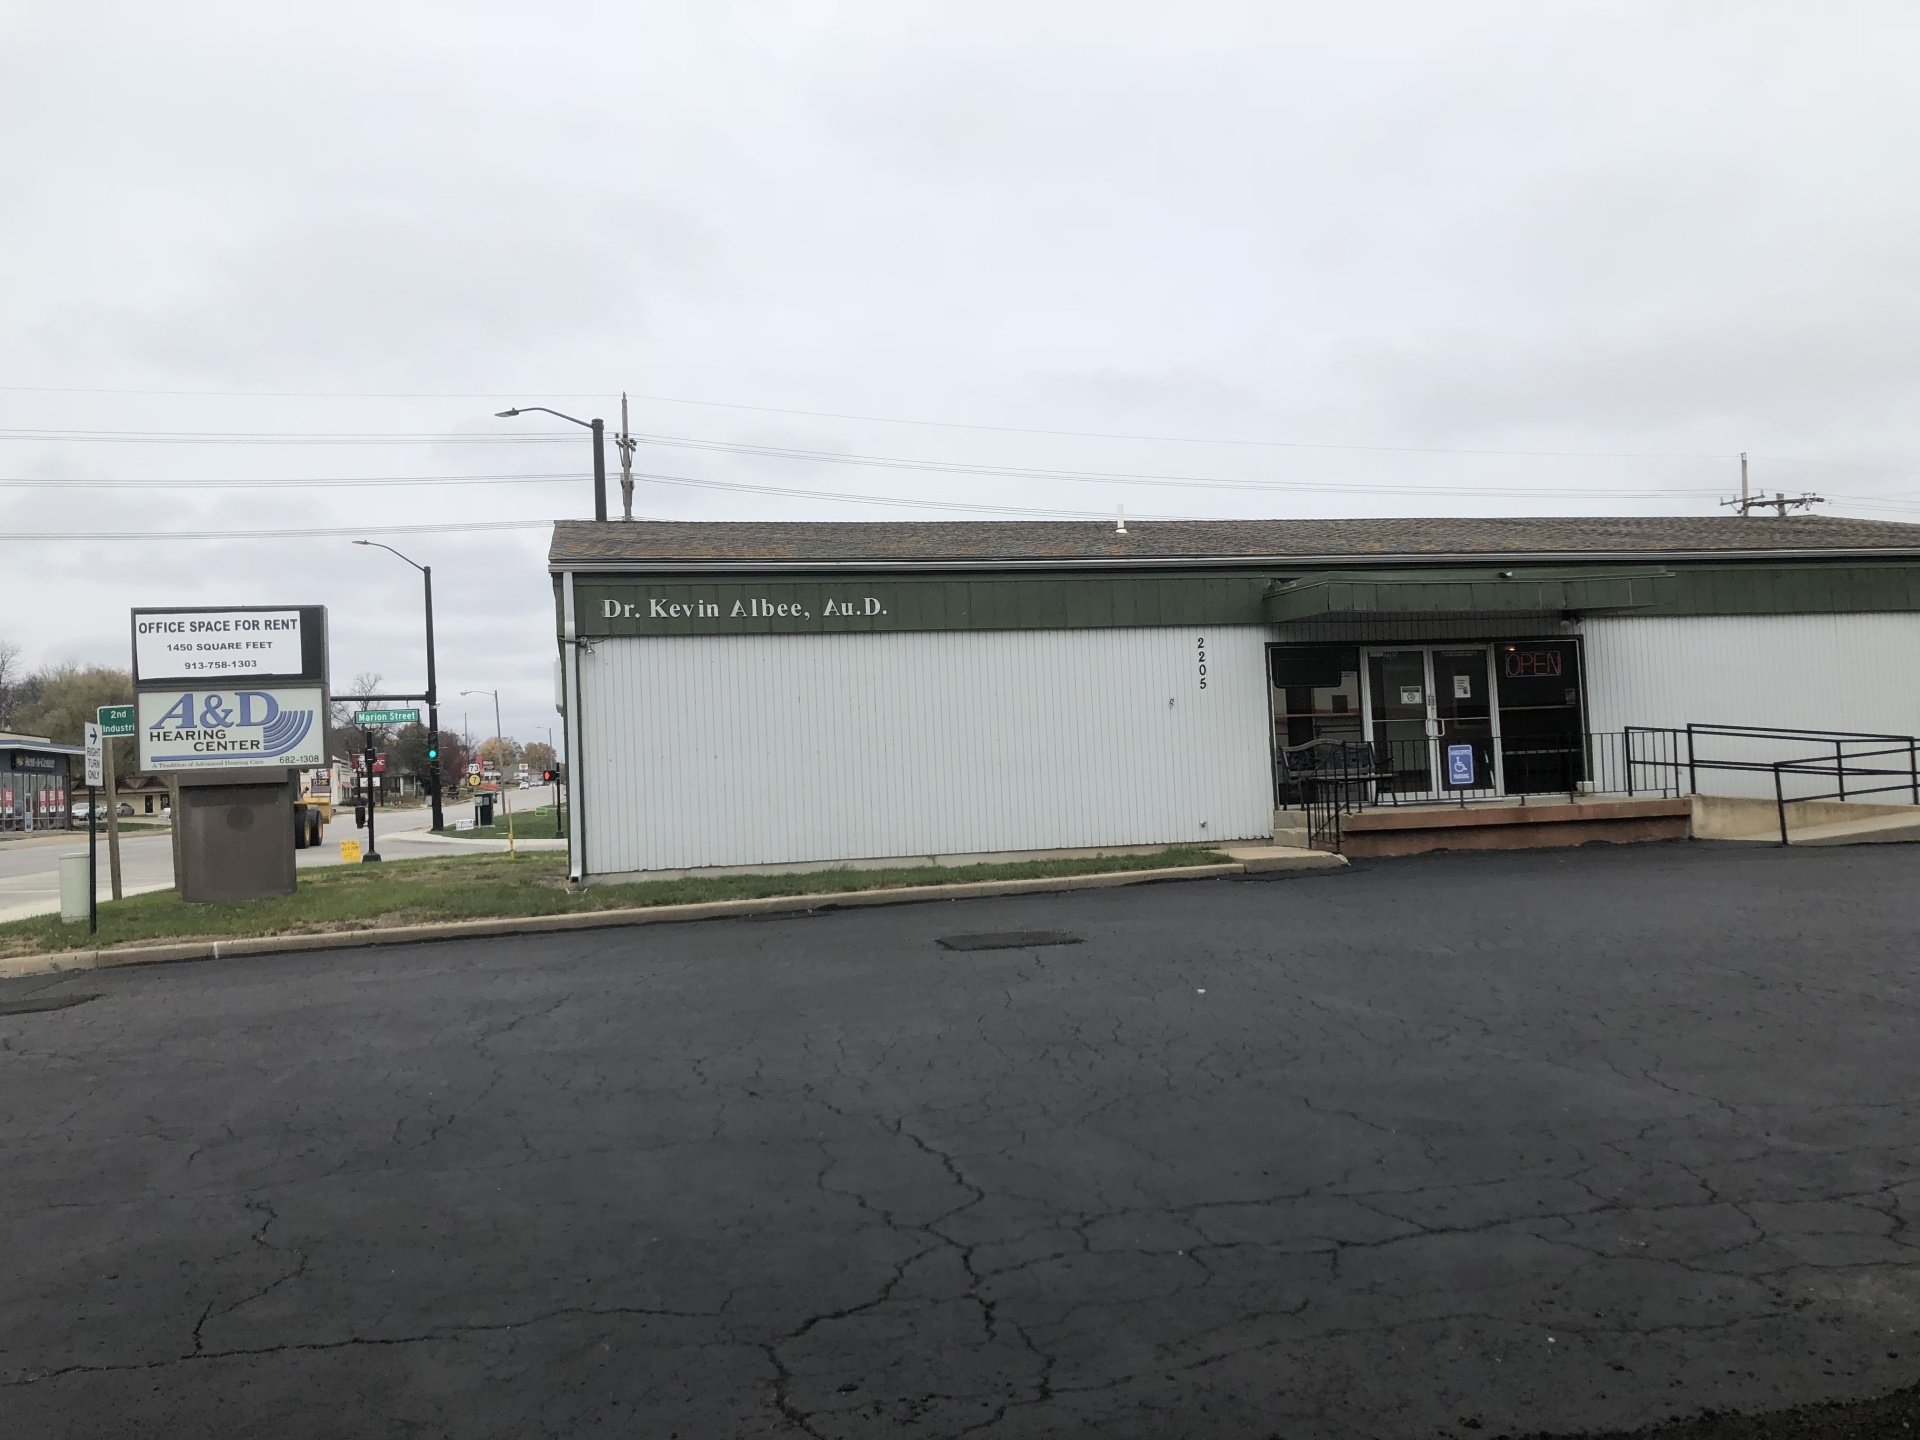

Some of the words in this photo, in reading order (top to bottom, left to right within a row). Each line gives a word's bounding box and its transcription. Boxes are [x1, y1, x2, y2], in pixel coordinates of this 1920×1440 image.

[602, 598, 641, 618] Dr.
[649, 598, 720, 618] Kevin
[730, 598, 811, 620] Albee,
[823, 597, 888, 616] Au.D.
[138, 621, 186, 634] OFFICE
[189, 620, 231, 633] SPACE
[234, 619, 260, 632] FOR
[264, 618, 298, 631] RENT
[166, 643, 193, 652] 1450
[196, 642, 243, 651] SQUARE
[245, 641, 273, 650] FEET
[184, 660, 258, 670] 913-758-1303
[1507, 652, 1561, 676] OPEN
[110, 710, 127, 719] 2nd
[149, 691, 279, 730] A&D
[358, 713, 387, 722] Marion
[389, 711, 416, 720] Street
[103, 723, 135, 733] Industri
[149, 729, 227, 742] HEARING
[193, 739, 261, 752] CENTER
[86, 746, 101, 757] RIGHT
[87, 758, 100, 769] TURN
[279, 755, 320, 764] 682-1308
[469, 764, 479, 772] 73
[87, 769, 100, 780] ONLY
